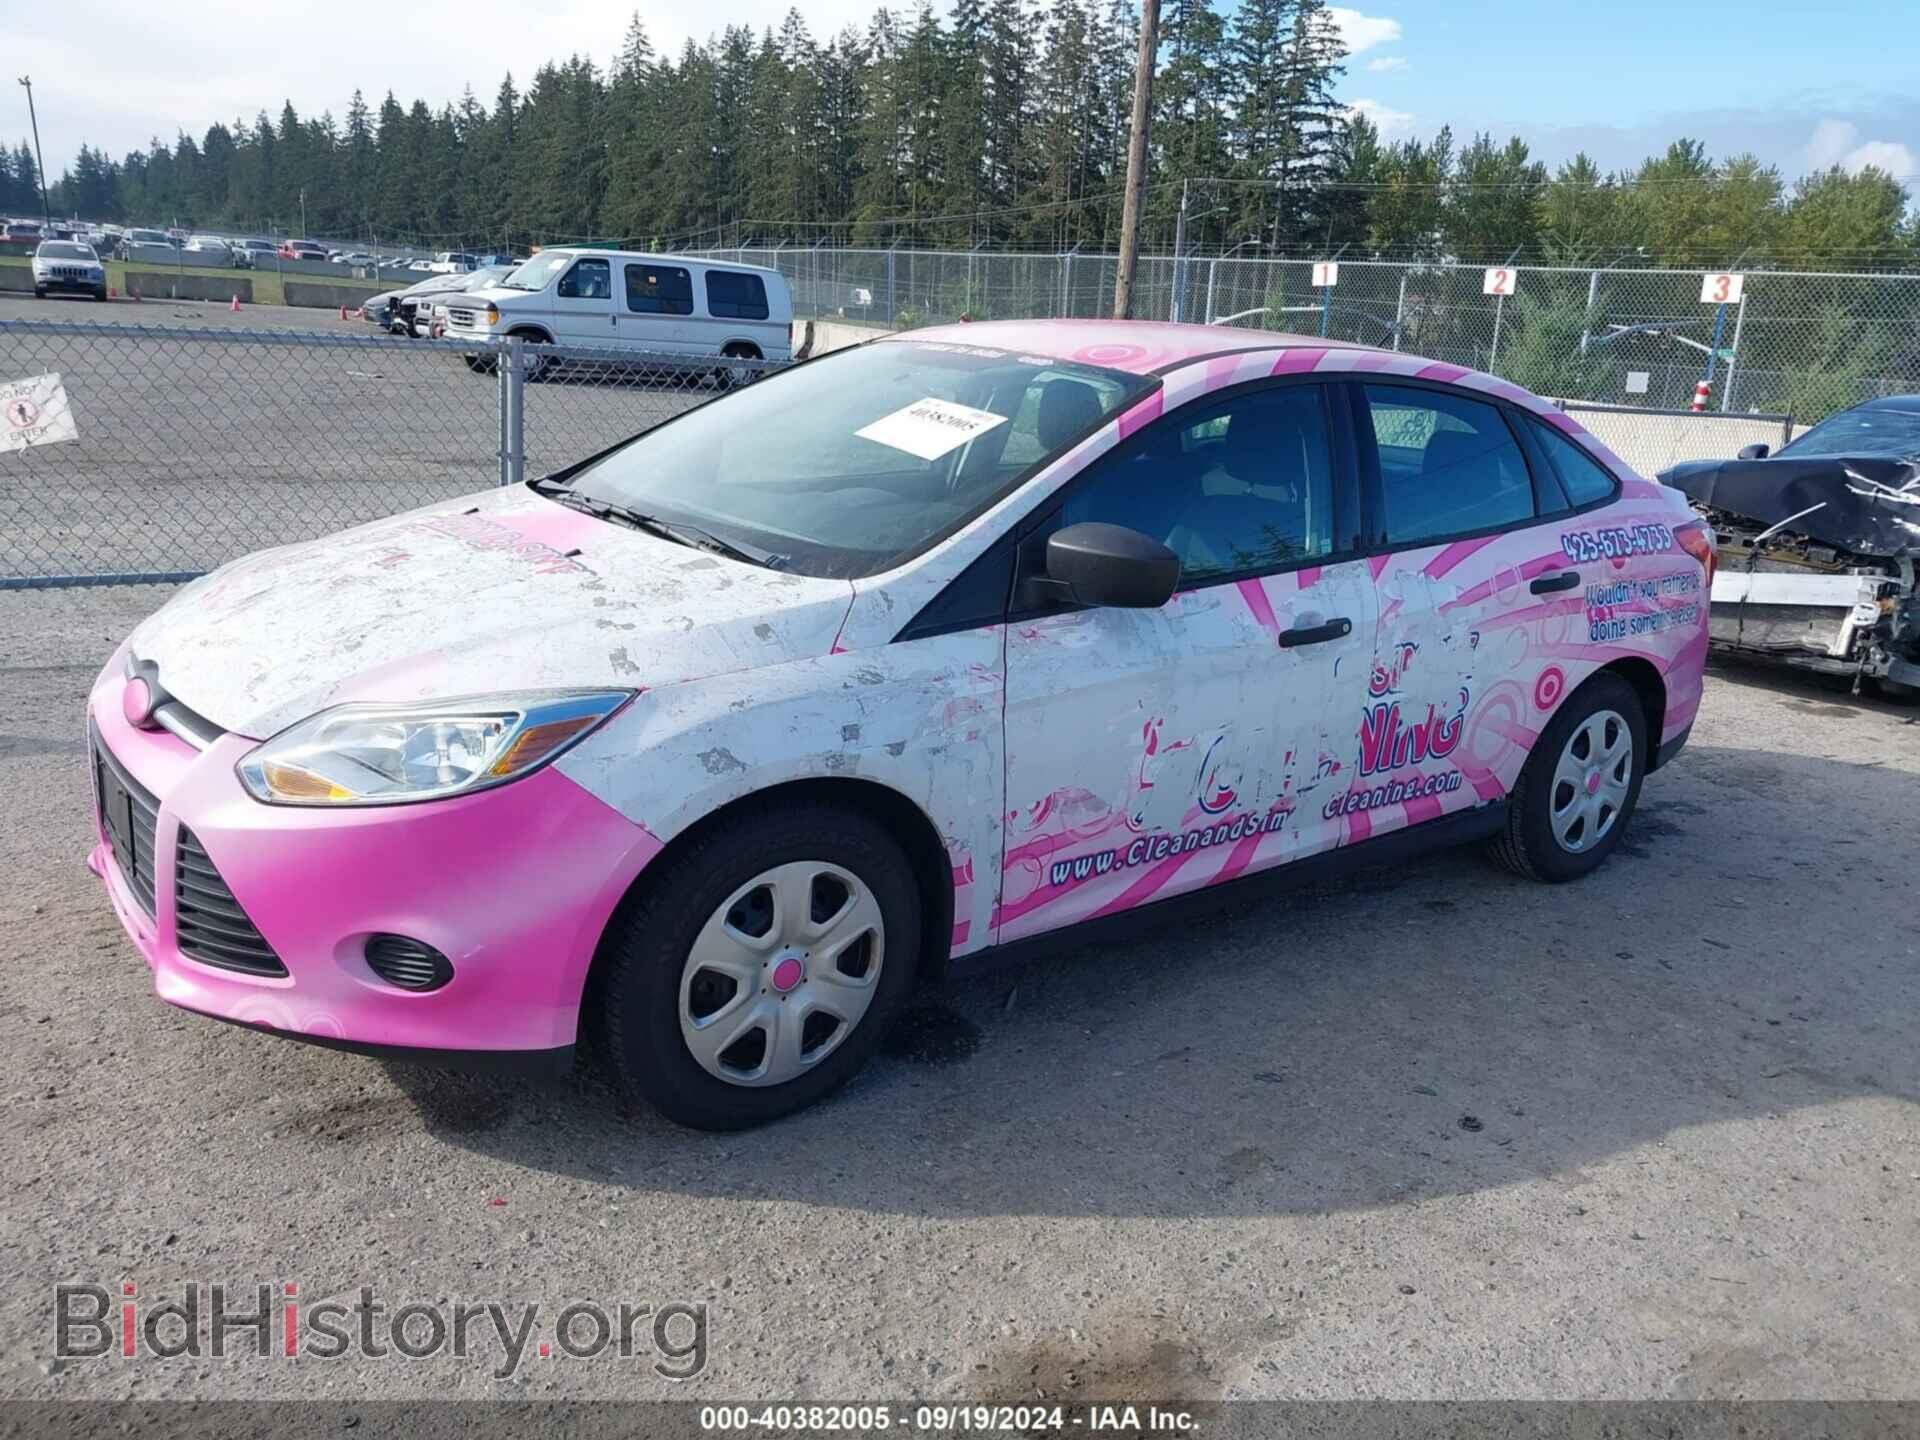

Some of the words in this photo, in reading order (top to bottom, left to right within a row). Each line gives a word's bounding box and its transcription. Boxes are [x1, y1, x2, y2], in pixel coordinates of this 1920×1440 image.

[1322, 263, 1329, 285] 1
[1493, 270, 1507, 293] 2
[1713, 276, 1730, 301] 3
[1586, 578, 1637, 606] Wouldn't
[1640, 580, 1660, 601] you
[1590, 616, 1627, 642] doing
